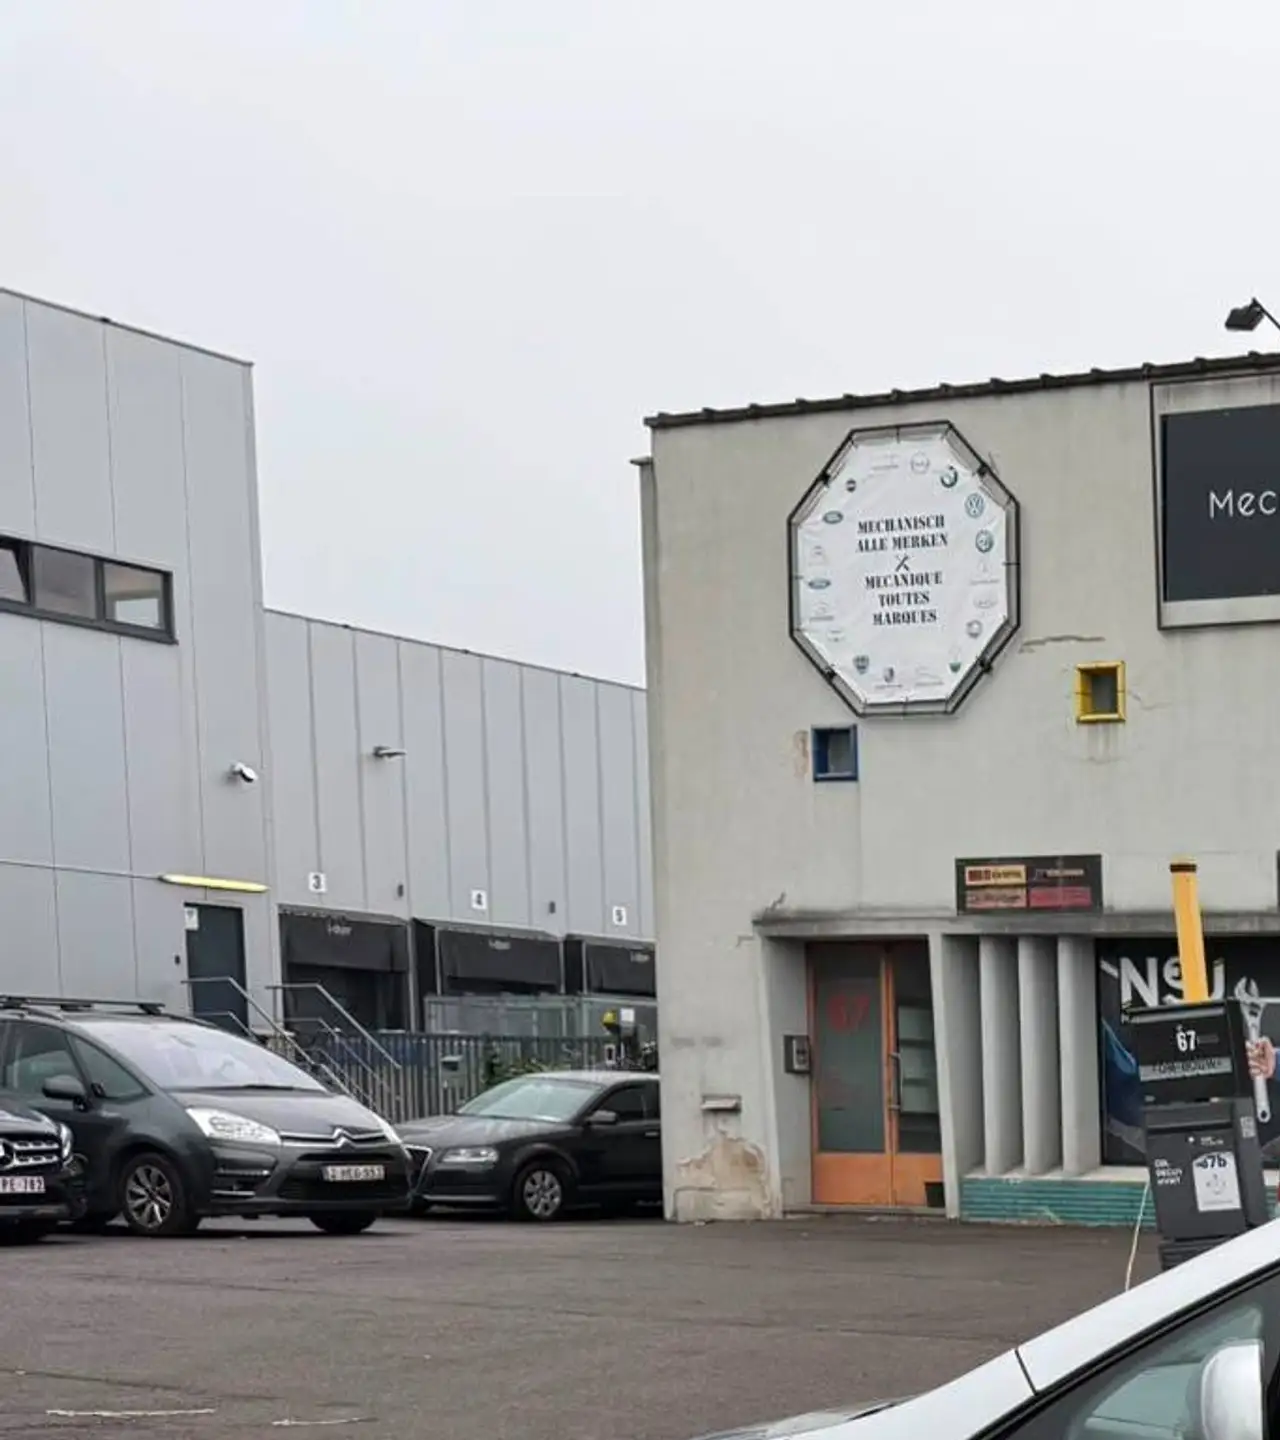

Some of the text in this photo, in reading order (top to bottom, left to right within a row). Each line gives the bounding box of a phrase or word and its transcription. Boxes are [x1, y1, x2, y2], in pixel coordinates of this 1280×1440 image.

[857, 514, 945, 534] MECHANISCH
[856, 532, 948, 553] ALLE MERKEN
[865, 571, 942, 590] MECANIQUE
[878, 591, 930, 607] TOUTES
[872, 609, 937, 626] MARQUES
[312, 874, 322, 890] 3
[1175, 1029, 1197, 1052] 67
